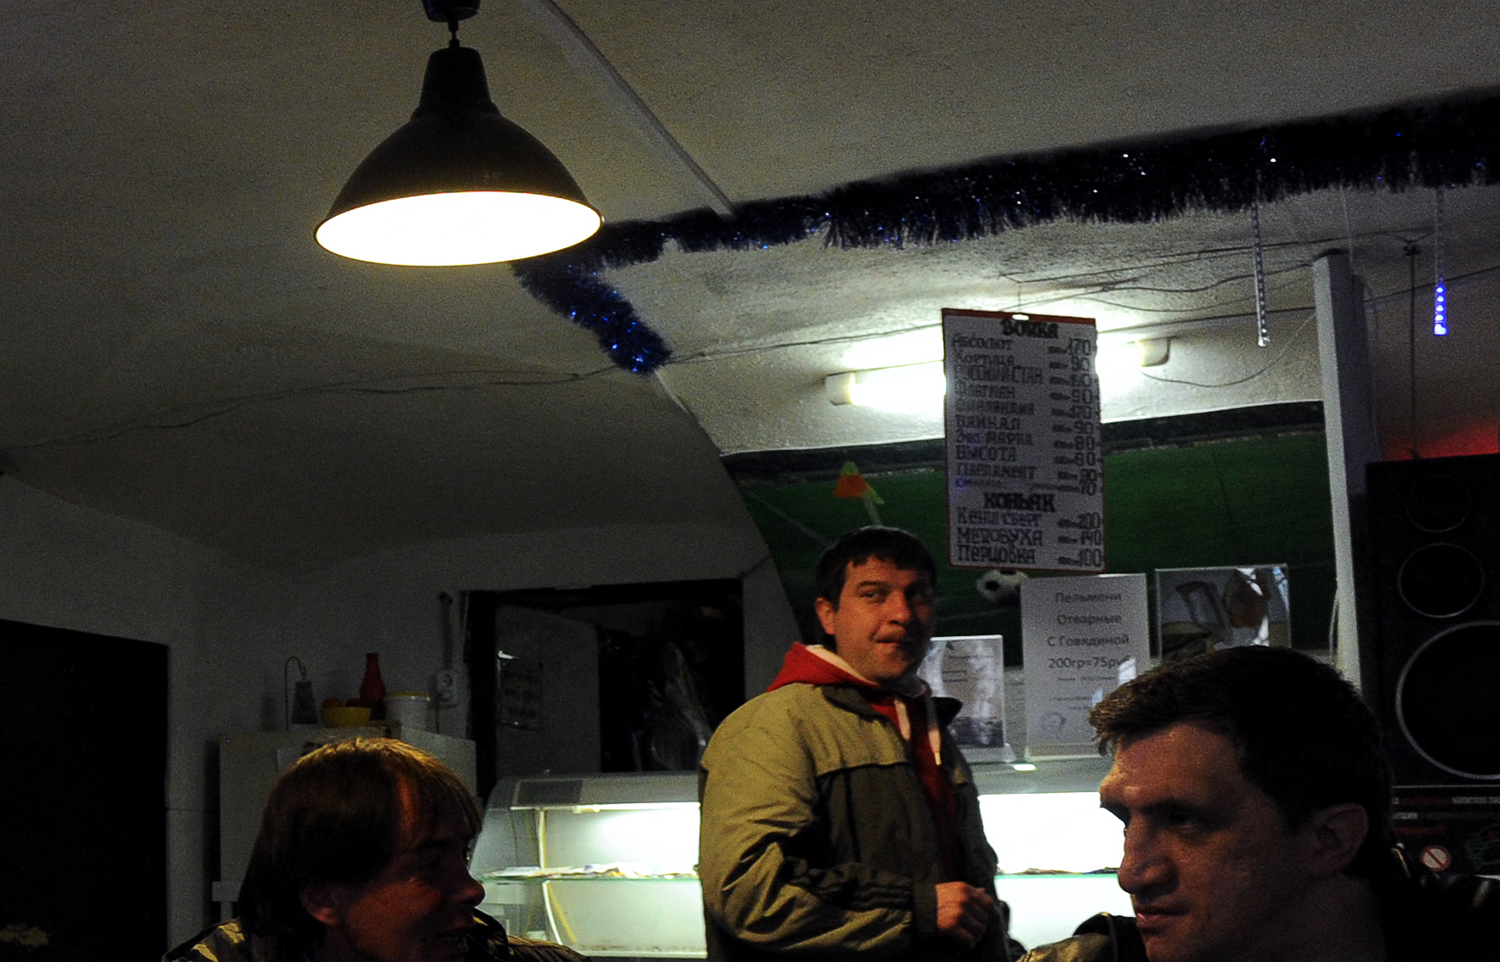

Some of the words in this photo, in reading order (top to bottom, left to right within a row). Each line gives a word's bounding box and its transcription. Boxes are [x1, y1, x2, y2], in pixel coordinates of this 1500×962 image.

[983, 492, 1057, 513] КОНЬЯК
[1054, 591, 1122, 604] Пельмени
[1056, 614, 1122, 626] Отварные
